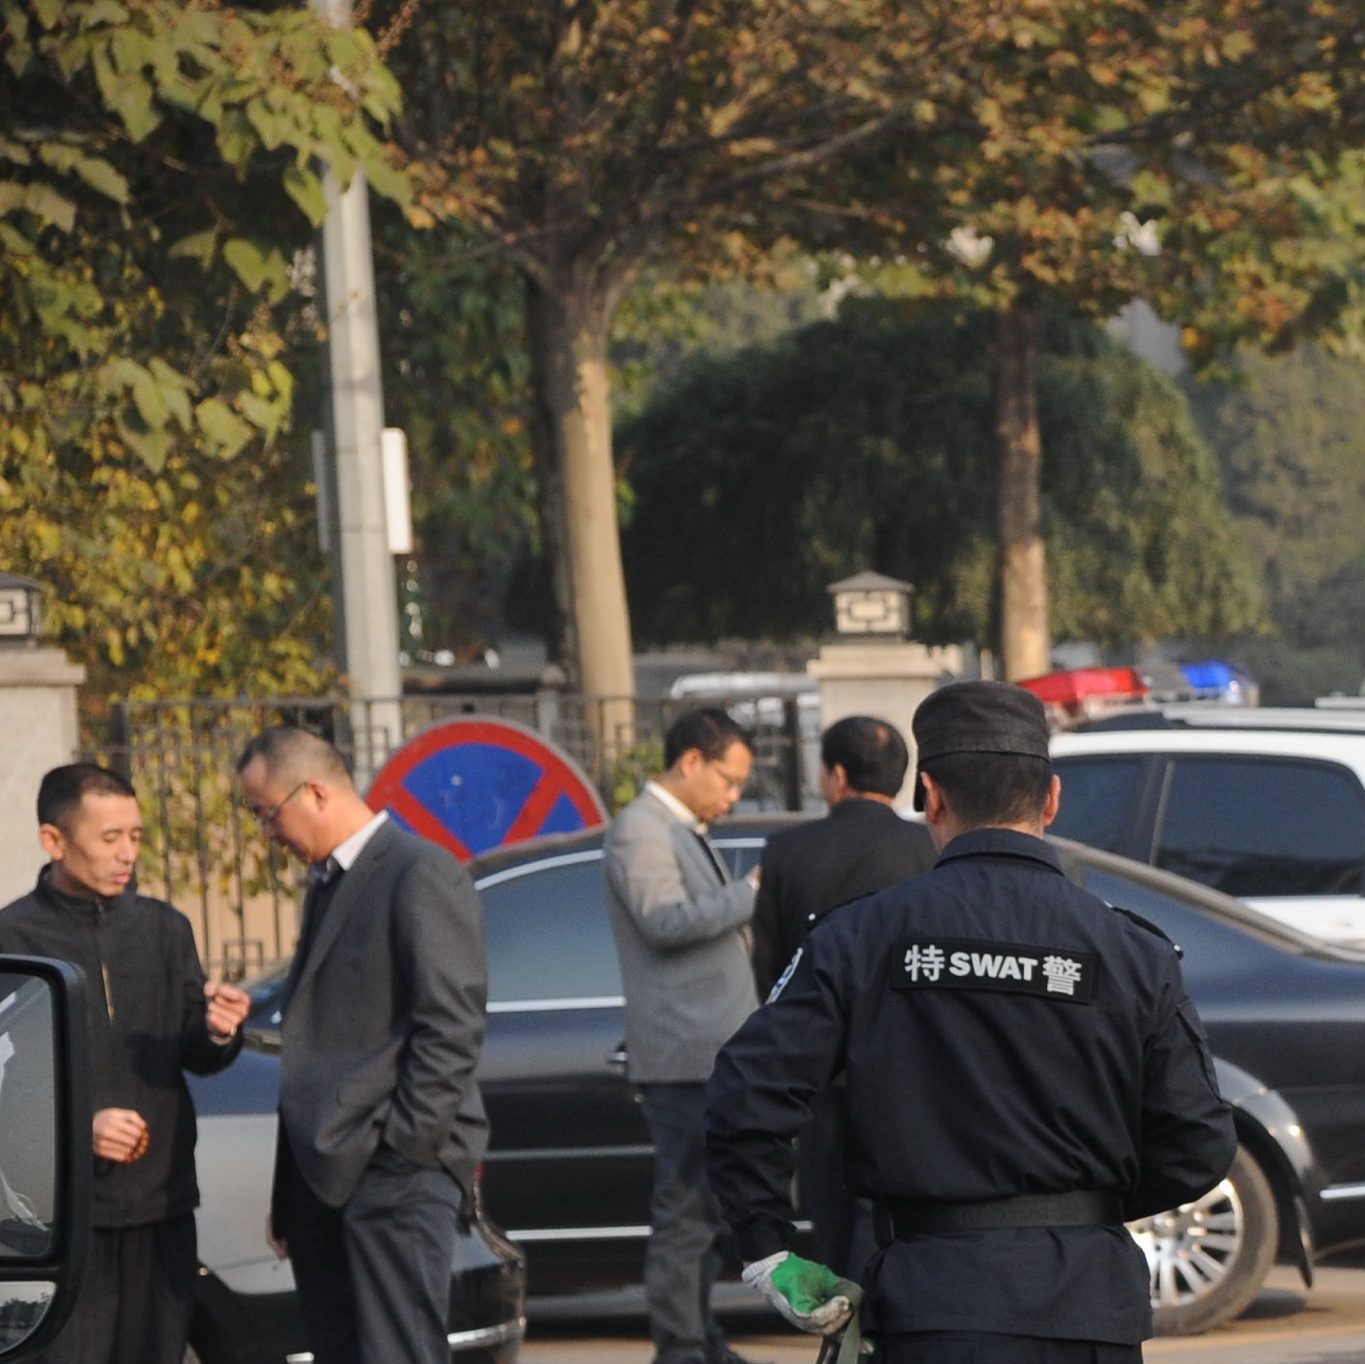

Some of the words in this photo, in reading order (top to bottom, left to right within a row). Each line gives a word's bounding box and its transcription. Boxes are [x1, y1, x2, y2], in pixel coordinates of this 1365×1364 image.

[904, 944, 946, 982] 特
[949, 952, 1038, 981] SWAT
[1042, 955, 1082, 996] 警
